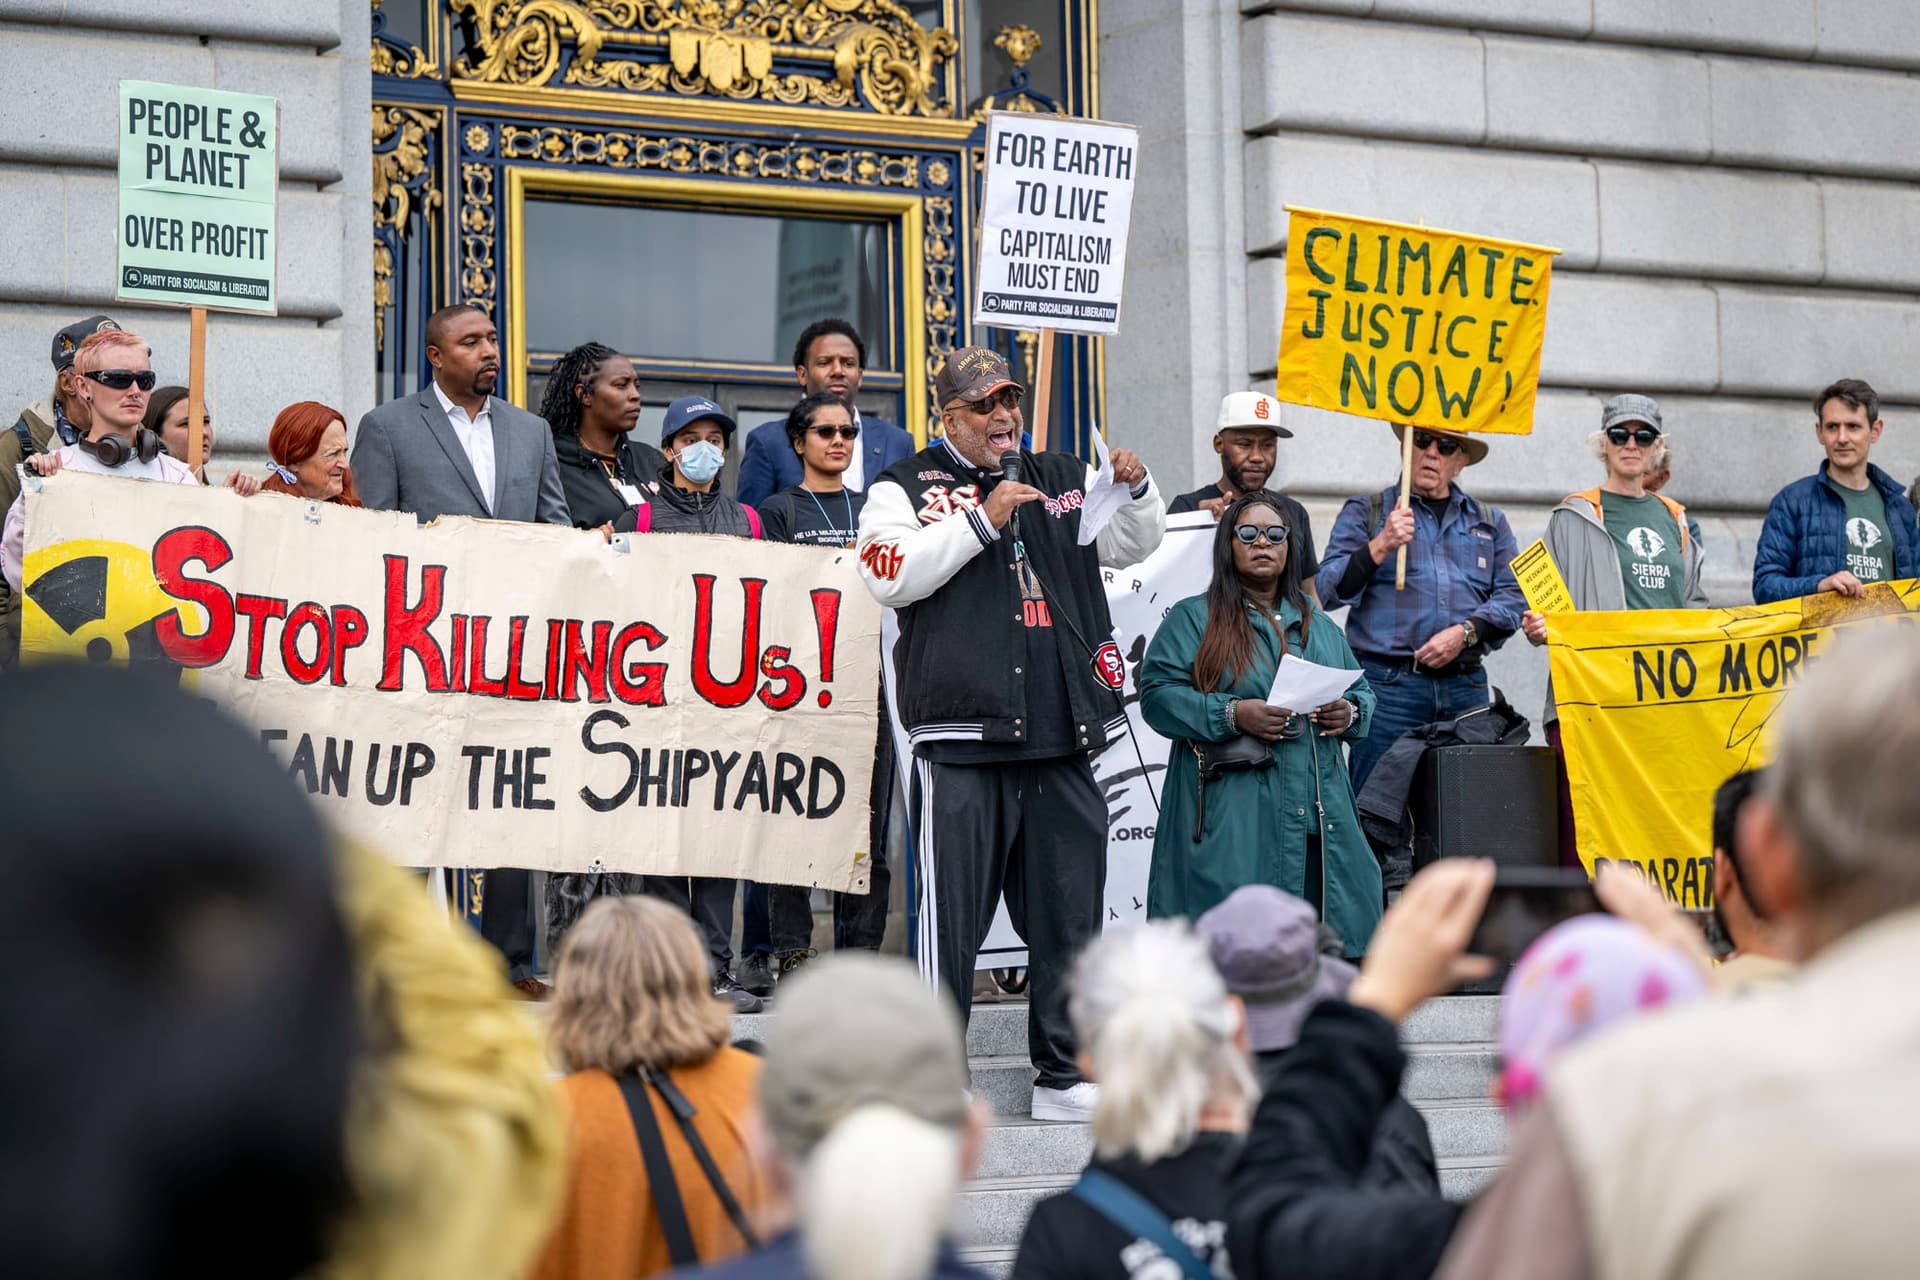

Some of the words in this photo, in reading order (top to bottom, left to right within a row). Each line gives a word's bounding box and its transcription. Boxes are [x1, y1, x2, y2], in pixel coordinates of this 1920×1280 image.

[129, 98, 232, 144] PEOPLE
[239, 111, 266, 149] &
[146, 143, 250, 189] PLANET
[996, 131, 1046, 169] FOR
[1053, 138, 1132, 180] EARTH
[1016, 180, 1047, 216] TO
[1054, 185, 1108, 223] LIVE
[125, 214, 184, 252] OVER
[191, 221, 269, 260] PROFIT
[1000, 228, 1111, 265] CAPITALISM
[143, 274, 166, 287] PARTY
[167, 278, 182, 289] FOR
[183, 278, 220, 292] SOCIALISM
[221, 283, 228, 293] &
[229, 282, 267, 297] LIBERATION
[1007, 262, 1060, 290] MUST
[1064, 267, 1099, 294] END
[1304, 227, 1537, 305] CLIMATE
[1001, 299, 1023, 312] PARTY
[1023, 301, 1037, 313] FOR
[1038, 302, 1073, 316] SOCIALISM
[1074, 305, 1080, 315] &
[1081, 305, 1115, 319] LIBERATION
[1302, 290, 1508, 363] JUSTICE
[957, 353, 975, 371] ARMY
[1340, 352, 1512, 420] NOW!
[1632, 562, 1671, 578] SIERRA
[1638, 576, 1665, 589] CLUB
[1846, 554, 1883, 569] SIERRA
[1853, 566, 1879, 580] CLUB
[152, 525, 369, 686] STOP
[376, 554, 669, 707] KILLING
[1633, 648, 1697, 701] NO
[1718, 631, 1820, 694] MORE
[366, 742, 436, 806] UP
[462, 746, 555, 810] THE
[579, 710, 845, 819] SHIPYARD
